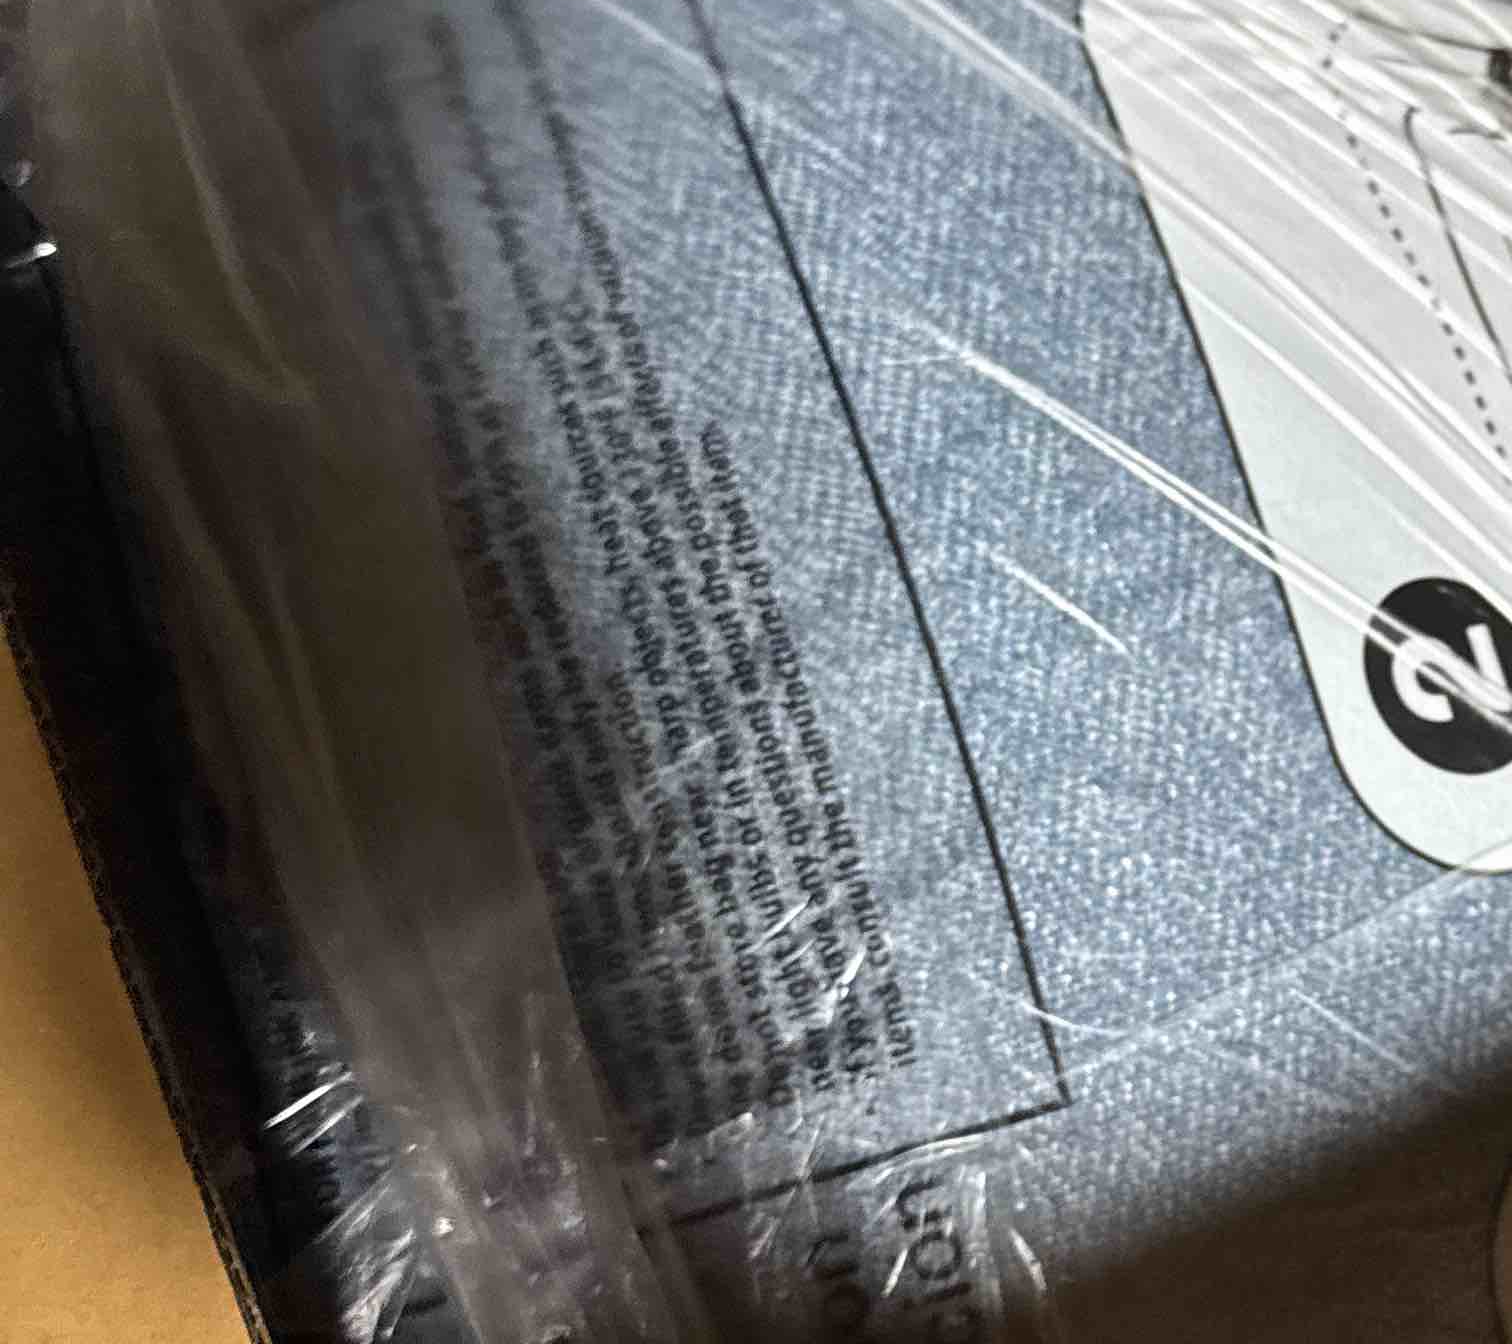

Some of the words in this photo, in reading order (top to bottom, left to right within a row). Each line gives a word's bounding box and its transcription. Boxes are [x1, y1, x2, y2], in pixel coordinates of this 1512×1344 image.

[548, 397, 611, 507] sources
[645, 431, 723, 557] possible
[584, 504, 634, 577] heat
[621, 482, 680, 576] above
[711, 492, 761, 559] that
[688, 554, 733, 609] the
[731, 550, 775, 594] of
[654, 572, 743, 775] temperatures
[704, 606, 763, 700] about
[748, 590, 841, 800] manufacturer
[735, 694, 816, 851] questions
[680, 781, 720, 850] near
[732, 812, 765, 849] or
[811, 797, 857, 856] the
[696, 851, 747, 918] bag
[790, 848, 838, 909] any
[826, 851, 893, 973] consult
[719, 918, 766, 1002] store
[764, 938, 824, 1023] light
